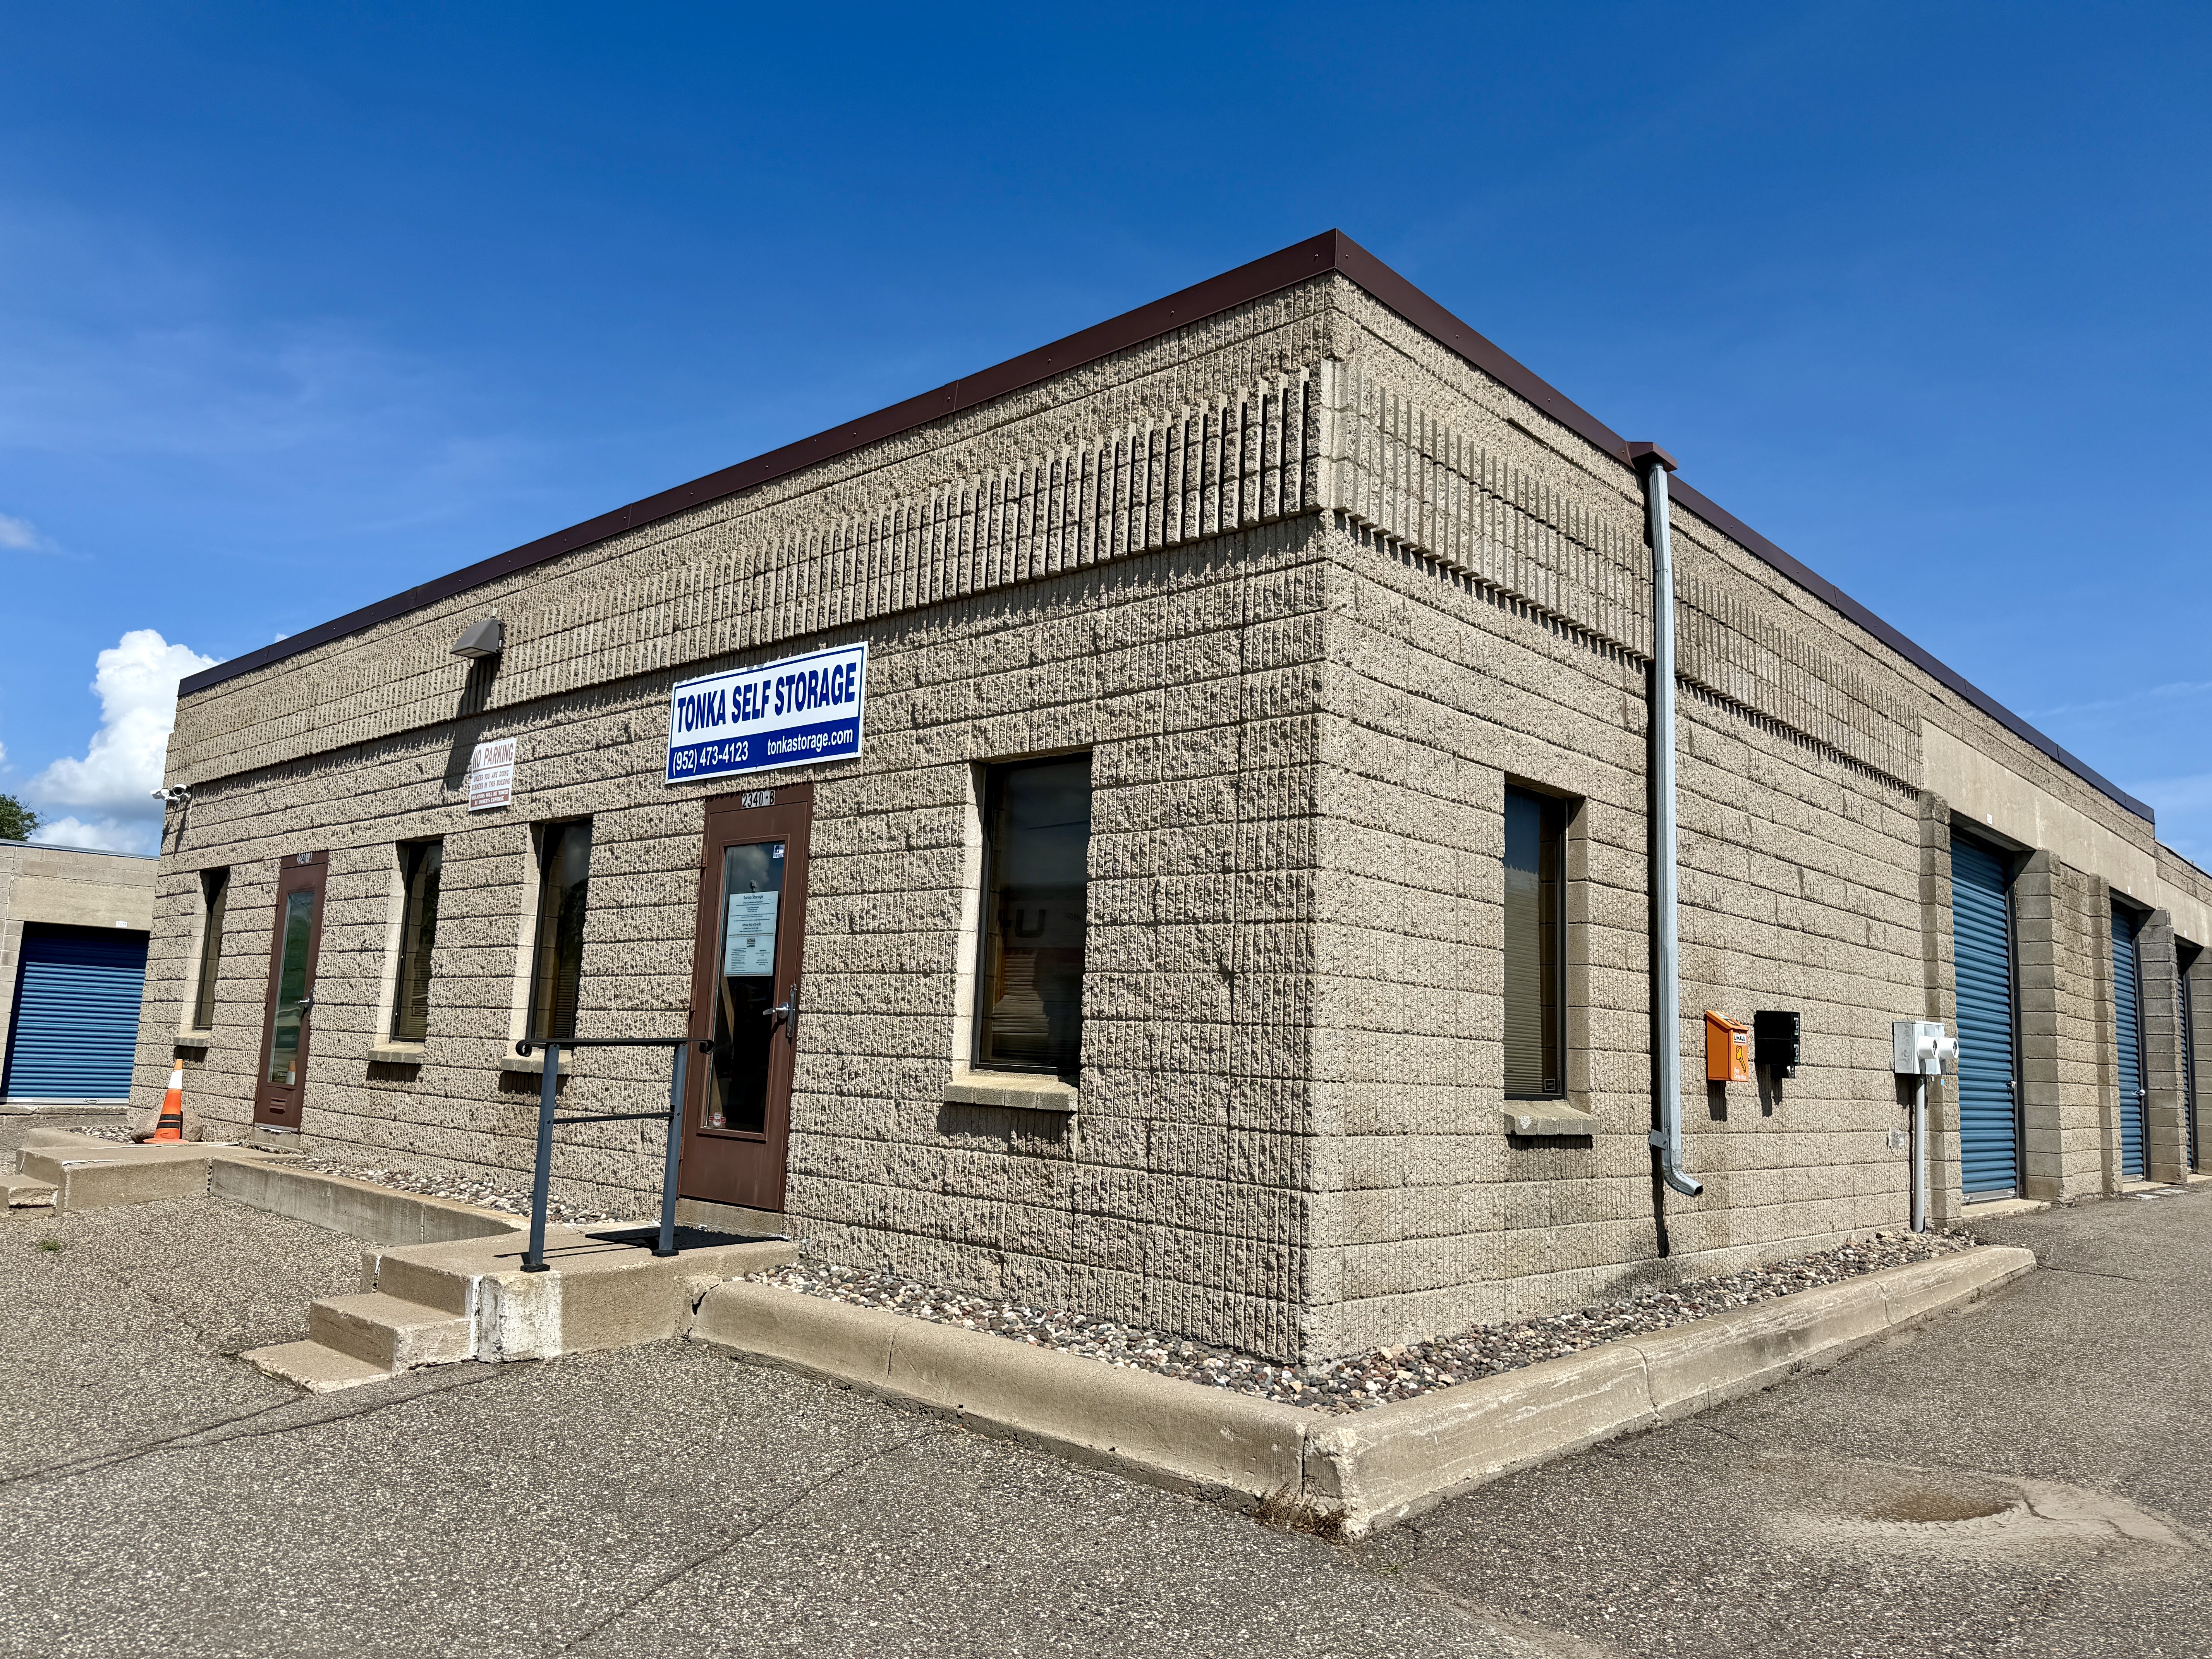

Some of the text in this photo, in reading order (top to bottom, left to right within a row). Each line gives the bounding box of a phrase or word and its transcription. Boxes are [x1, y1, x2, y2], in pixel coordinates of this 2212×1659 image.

[677, 662, 856, 733] TONKA SELF STORAGE
[473, 743, 514, 769] NO PARKING
[673, 729, 853, 776] (952) 473-4123 tonkastorage.com
[742, 791, 774, 807] 2340-B
